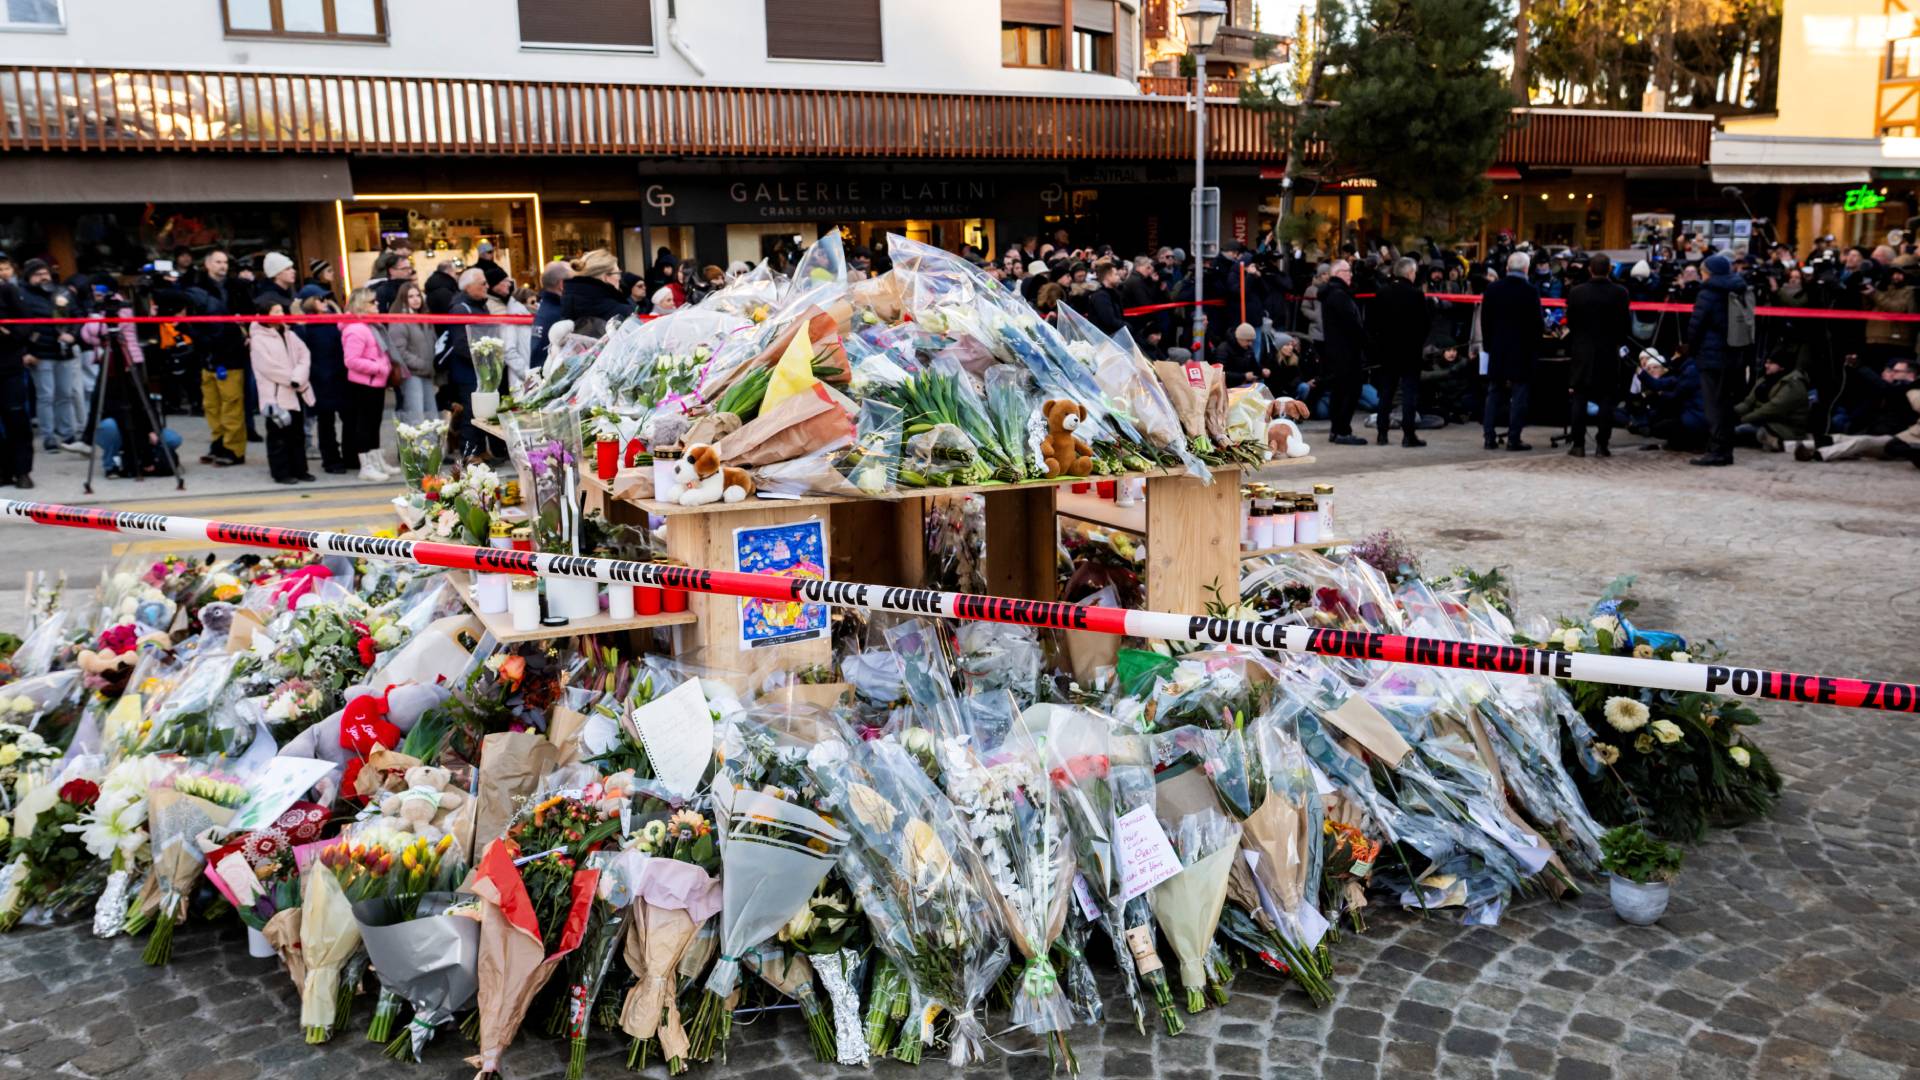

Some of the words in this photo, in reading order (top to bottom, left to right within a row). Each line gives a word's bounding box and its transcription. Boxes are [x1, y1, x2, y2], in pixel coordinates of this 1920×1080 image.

[730, 181, 861, 203] GALERIE
[880, 181, 997, 201] PLATINI
[760, 207, 803, 217] CRANS
[806, 206, 868, 217] MONTANA
[881, 205, 912, 216] LYON
[923, 204, 971, 215] ANNECY
[218, 523, 271, 543] POLICE
[278, 529, 320, 549] ZONE
[328, 534, 413, 558] INTERDITE
[475, 548, 538, 571] POLICE
[548, 555, 599, 578] ZONE
[609, 561, 712, 590] INTERDITE
[790, 579, 869, 606] POLICE
[881, 587, 943, 614] ZONE
[956, 595, 1088, 628] INTERDITE
[1188, 616, 1288, 649] POLICE
[1305, 628, 1384, 660] ZONE
[1405, 637, 1573, 677] INTERDITE
[1706, 665, 1838, 704] POLICE
[1861, 681, 1920, 713] ZO
[361, 724, 378, 739] Love
